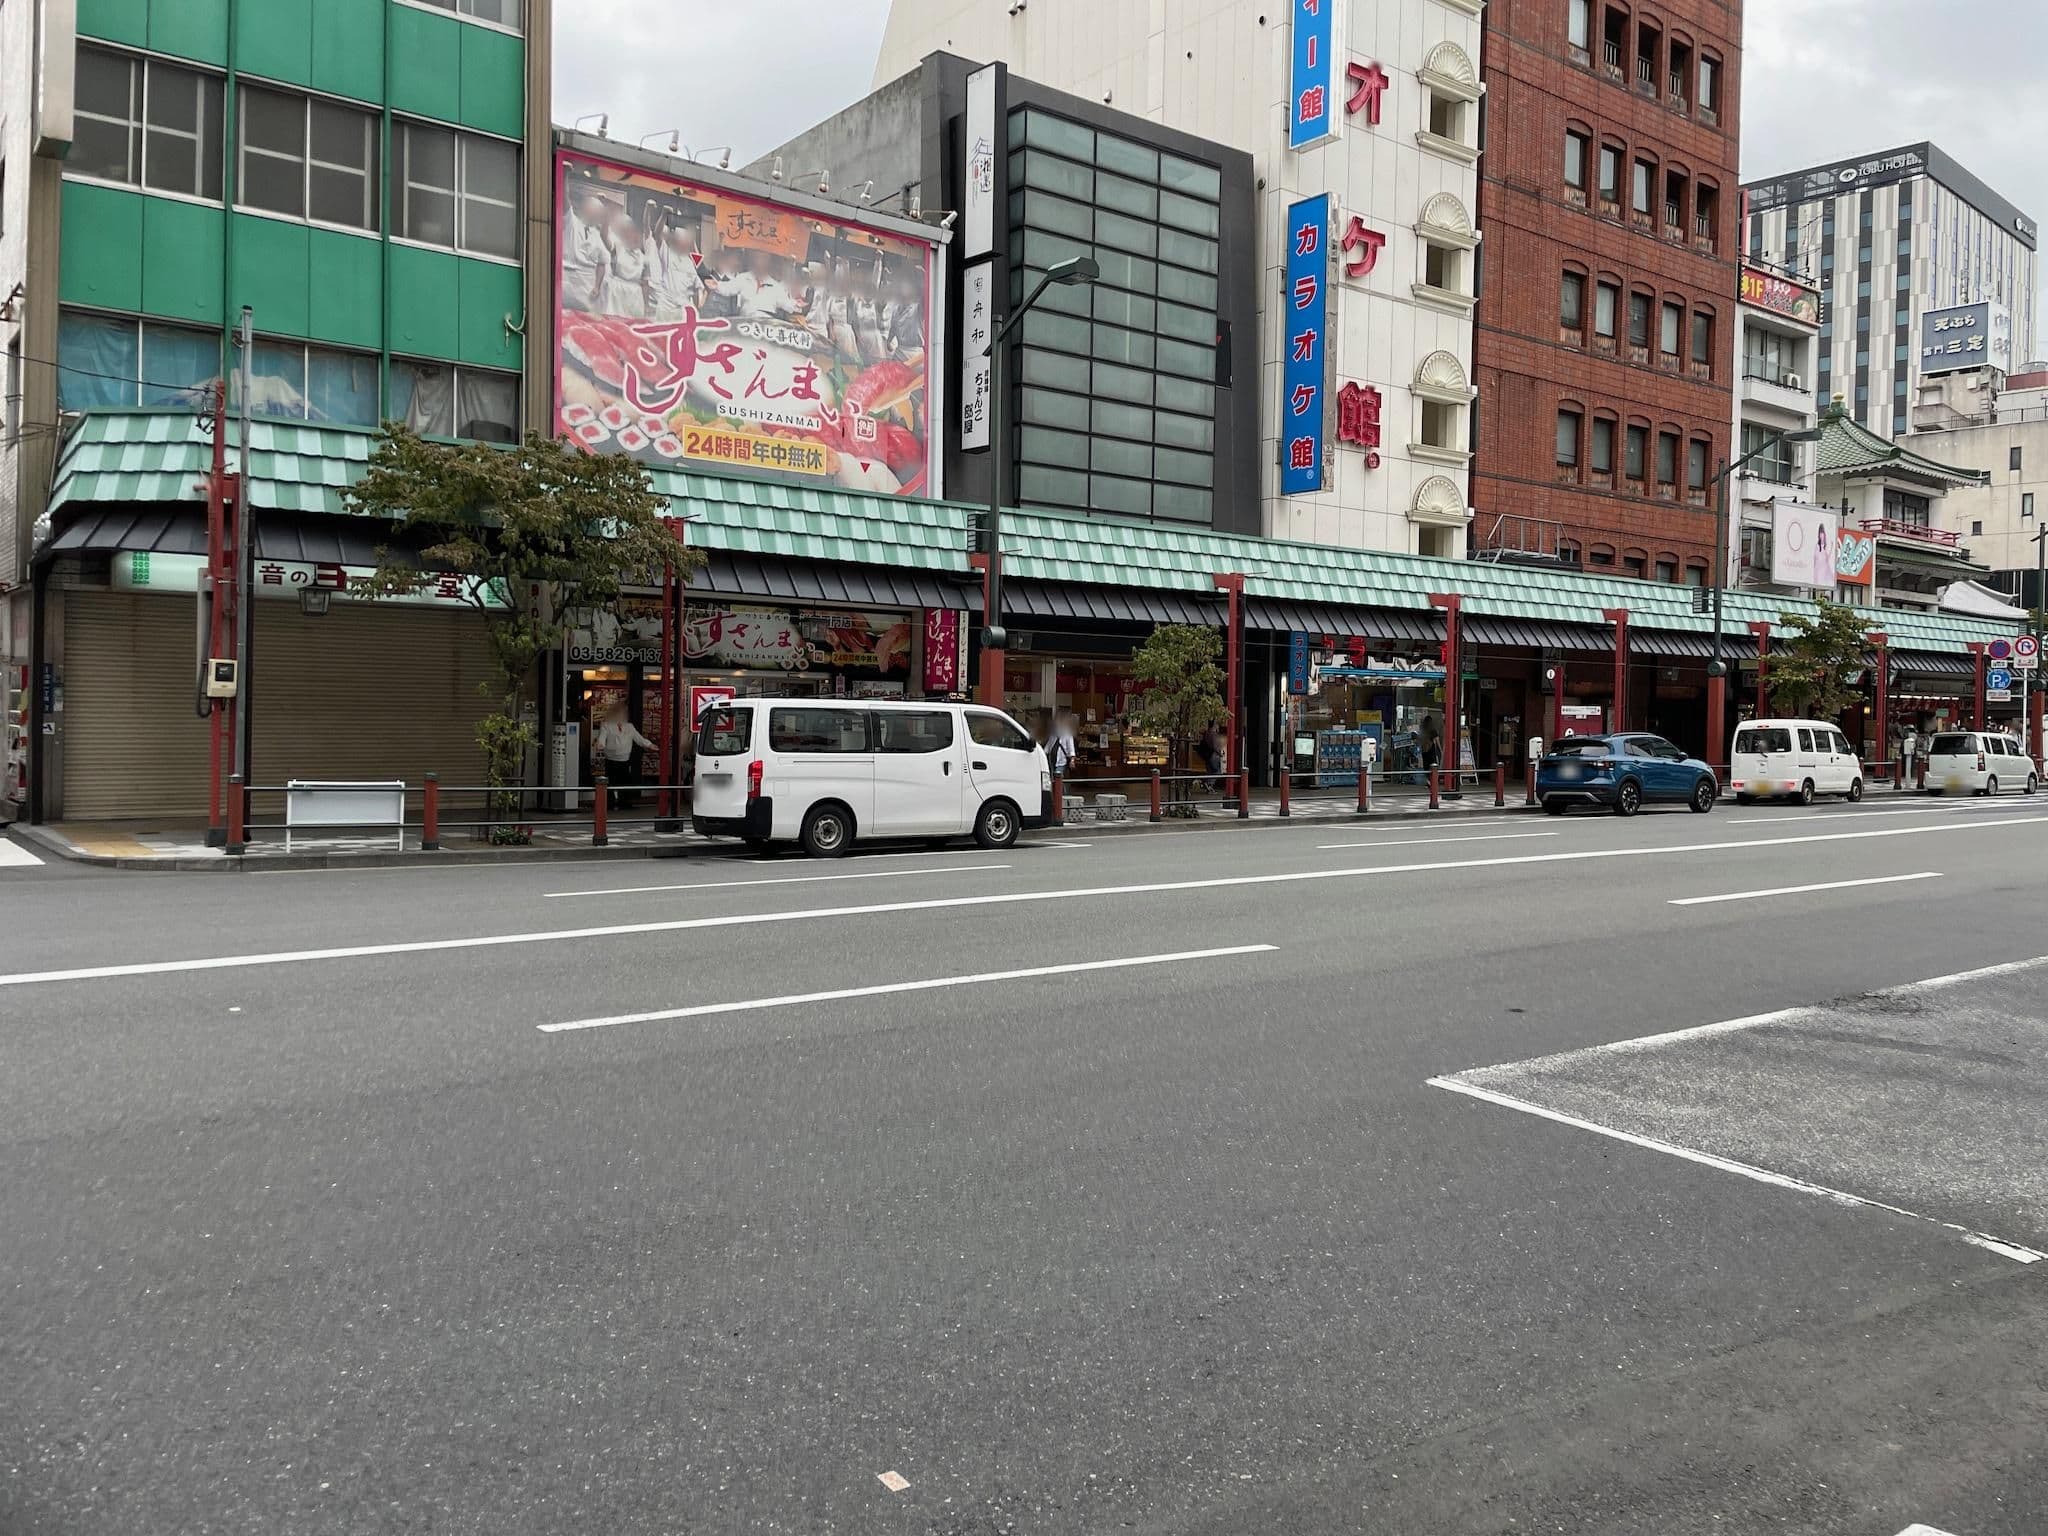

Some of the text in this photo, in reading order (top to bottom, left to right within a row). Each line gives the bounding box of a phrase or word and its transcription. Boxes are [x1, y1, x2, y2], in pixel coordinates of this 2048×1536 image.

[1934, 314, 1976, 332] 天ぷら
[739, 322, 812, 348] つきじ喜代村
[1291, 222, 1319, 469] カラオケ館
[1947, 334, 1984, 354] 三定
[719, 404, 820, 429] SUSHIZANMAI
[686, 431, 824, 470] 24時間年中無休
[571, 646, 674, 662] 03-5826-137
[1992, 675, 2002, 688] P
